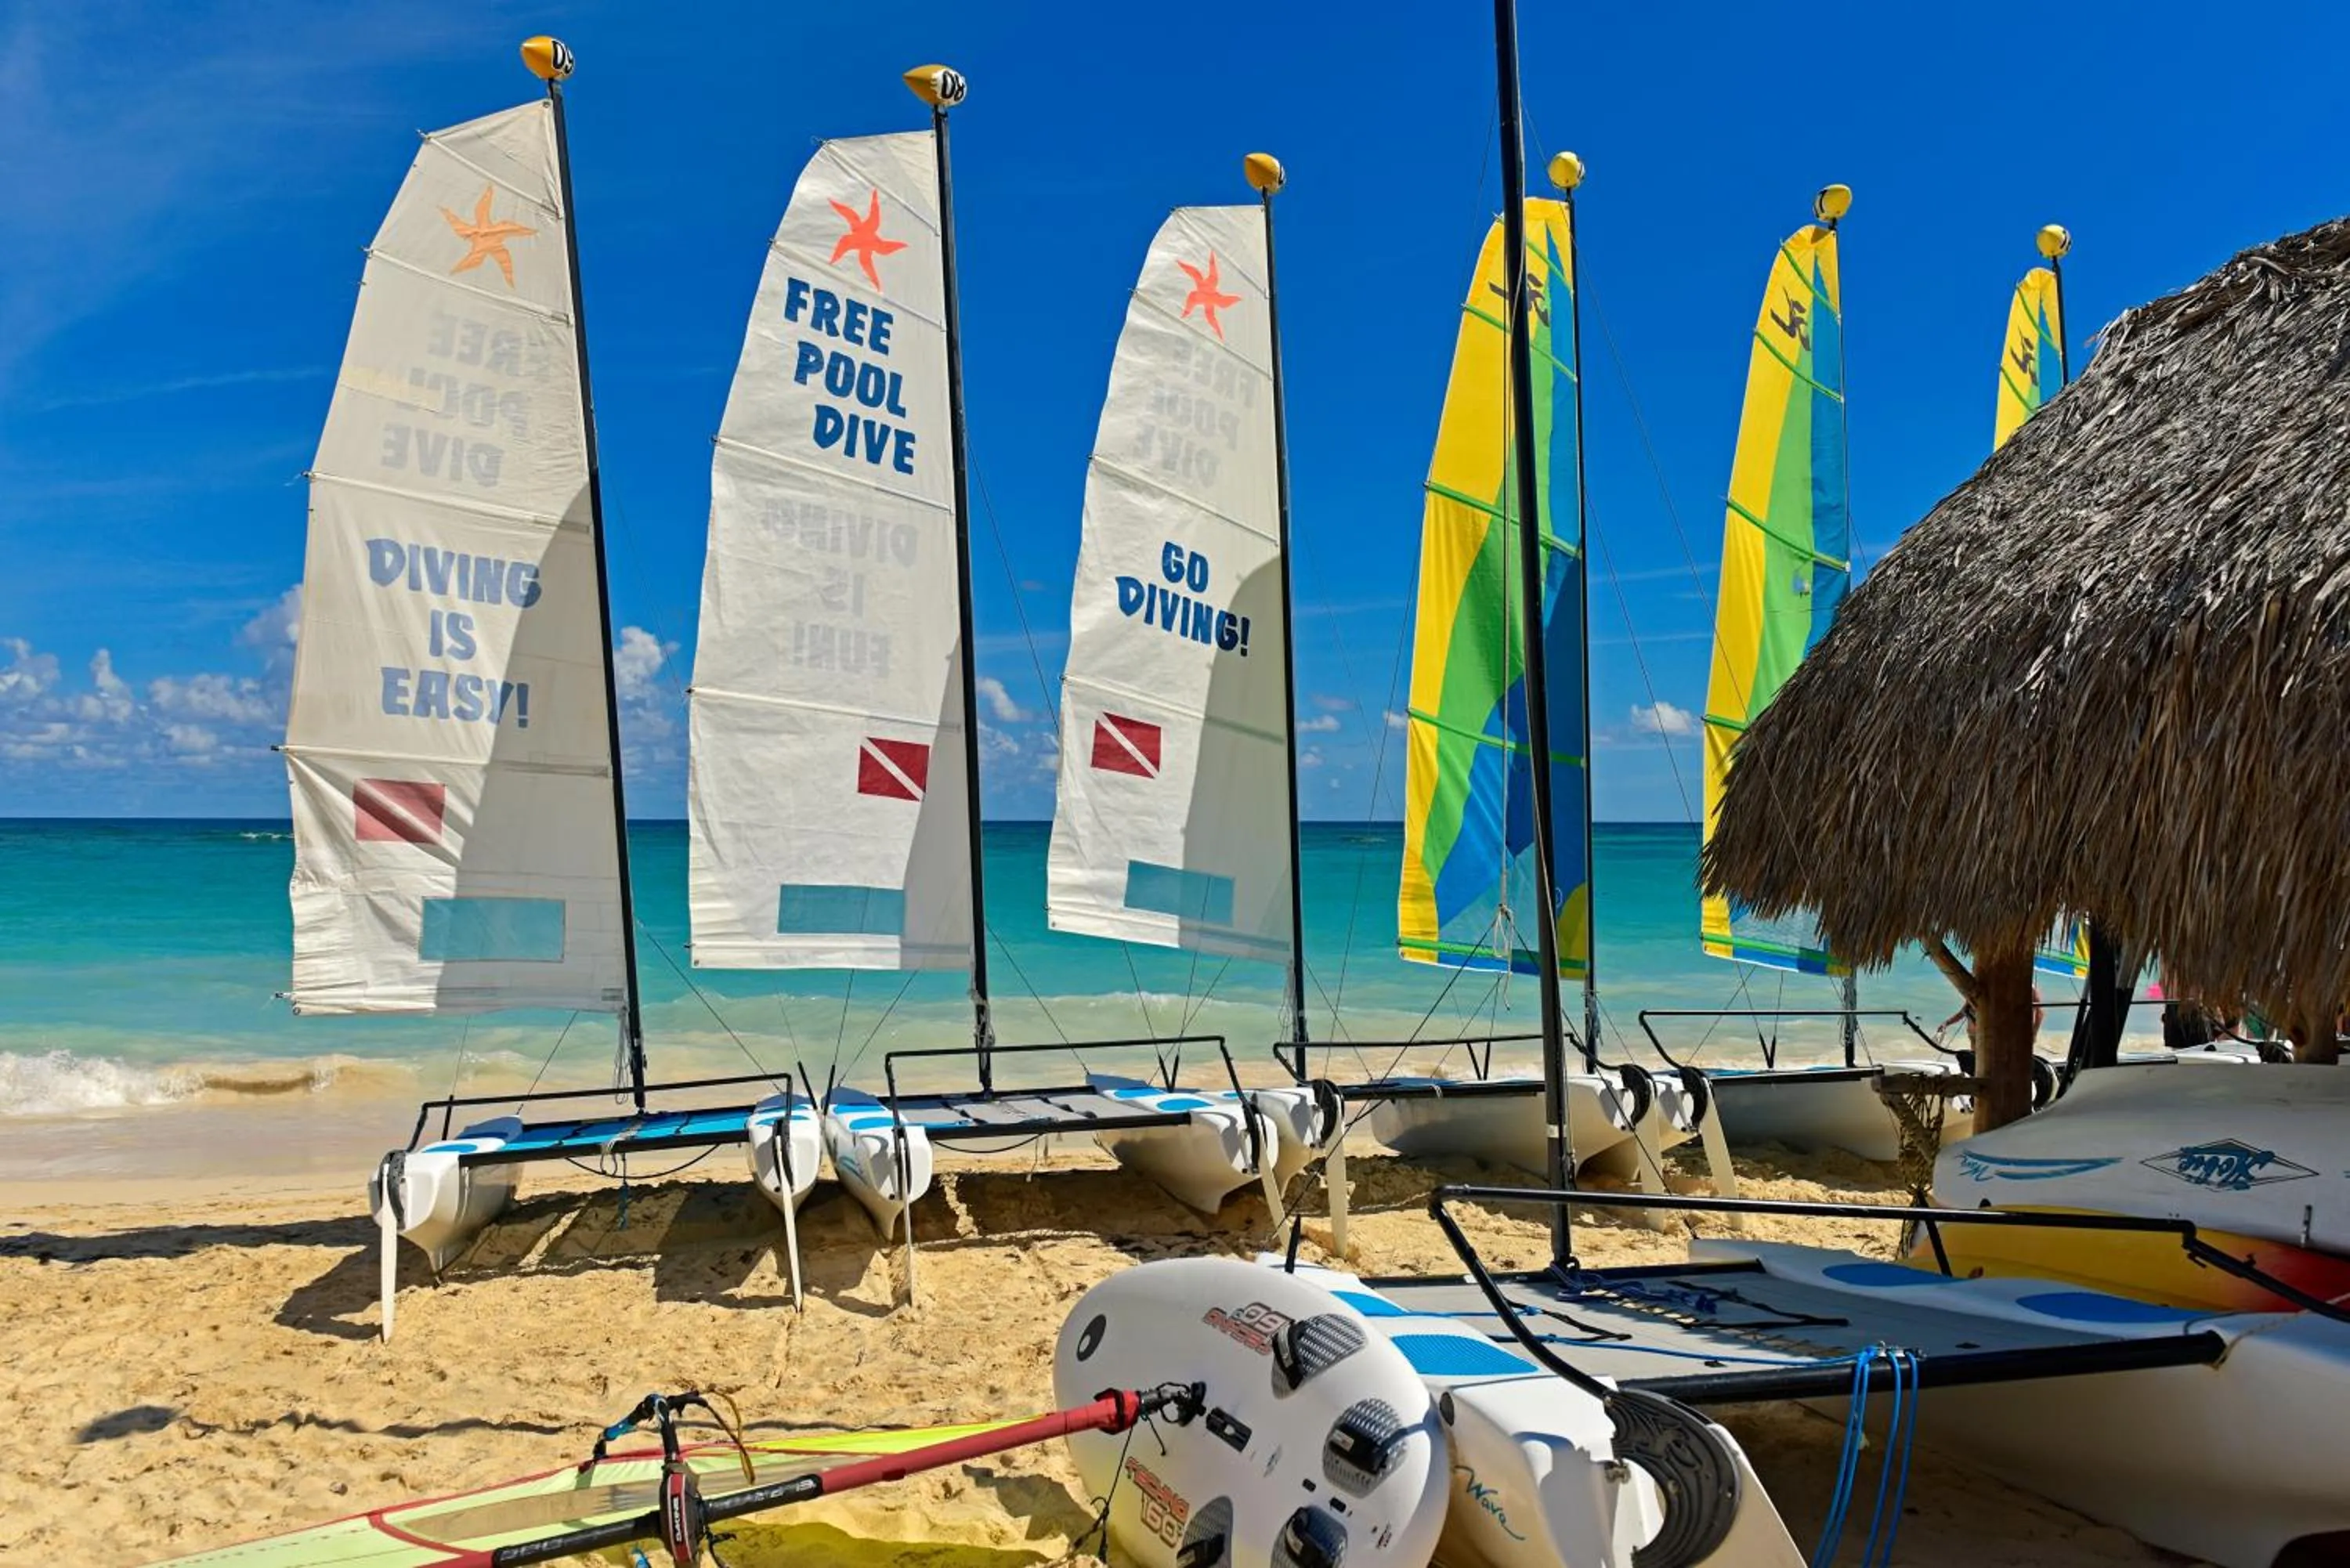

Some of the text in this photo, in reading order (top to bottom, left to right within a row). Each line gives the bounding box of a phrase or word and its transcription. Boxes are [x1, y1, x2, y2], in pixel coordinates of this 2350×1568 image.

[784, 276, 894, 356] FREE
[794, 341, 906, 418] POOL
[813, 404, 916, 475] DIVE
[365, 538, 542, 609] DIVING
[1162, 541, 1209, 593] GO
[429, 609, 477, 660] IS
[1115, 576, 1250, 657] DIVING!
[381, 667, 529, 728] EASY!
[1454, 1465, 1526, 1541] Wave
